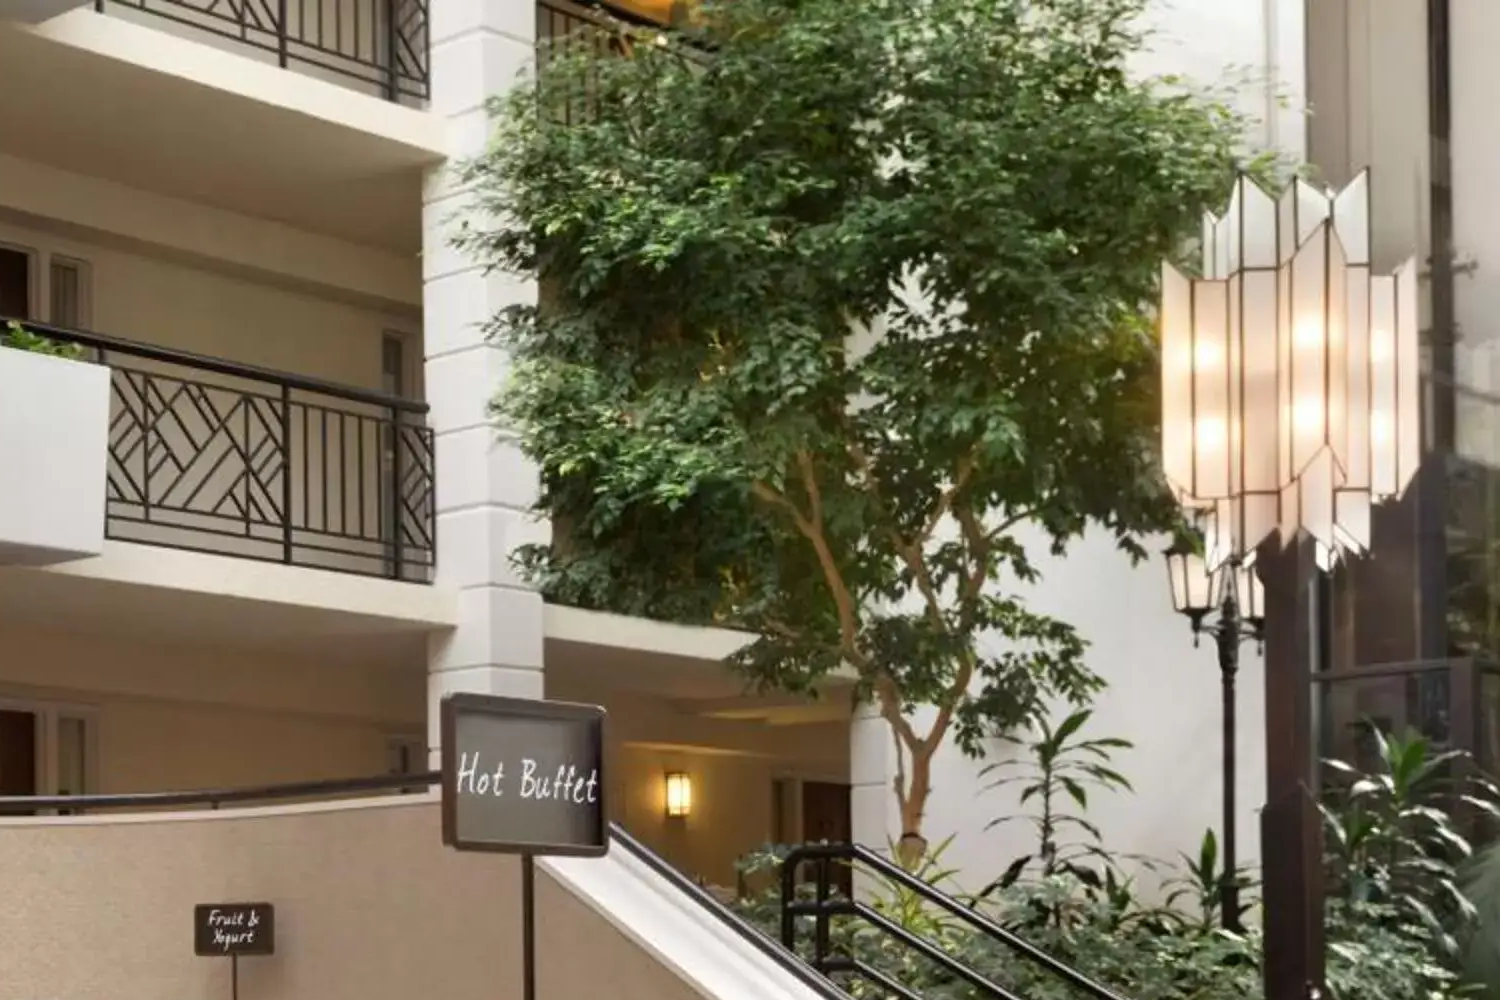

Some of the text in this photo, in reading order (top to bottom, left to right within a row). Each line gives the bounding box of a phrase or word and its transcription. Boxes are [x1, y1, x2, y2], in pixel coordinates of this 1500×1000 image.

[457, 751, 599, 804] Hot Buffet
[208, 908, 261, 927] Fruit &
[211, 928, 254, 953] Yogurt
